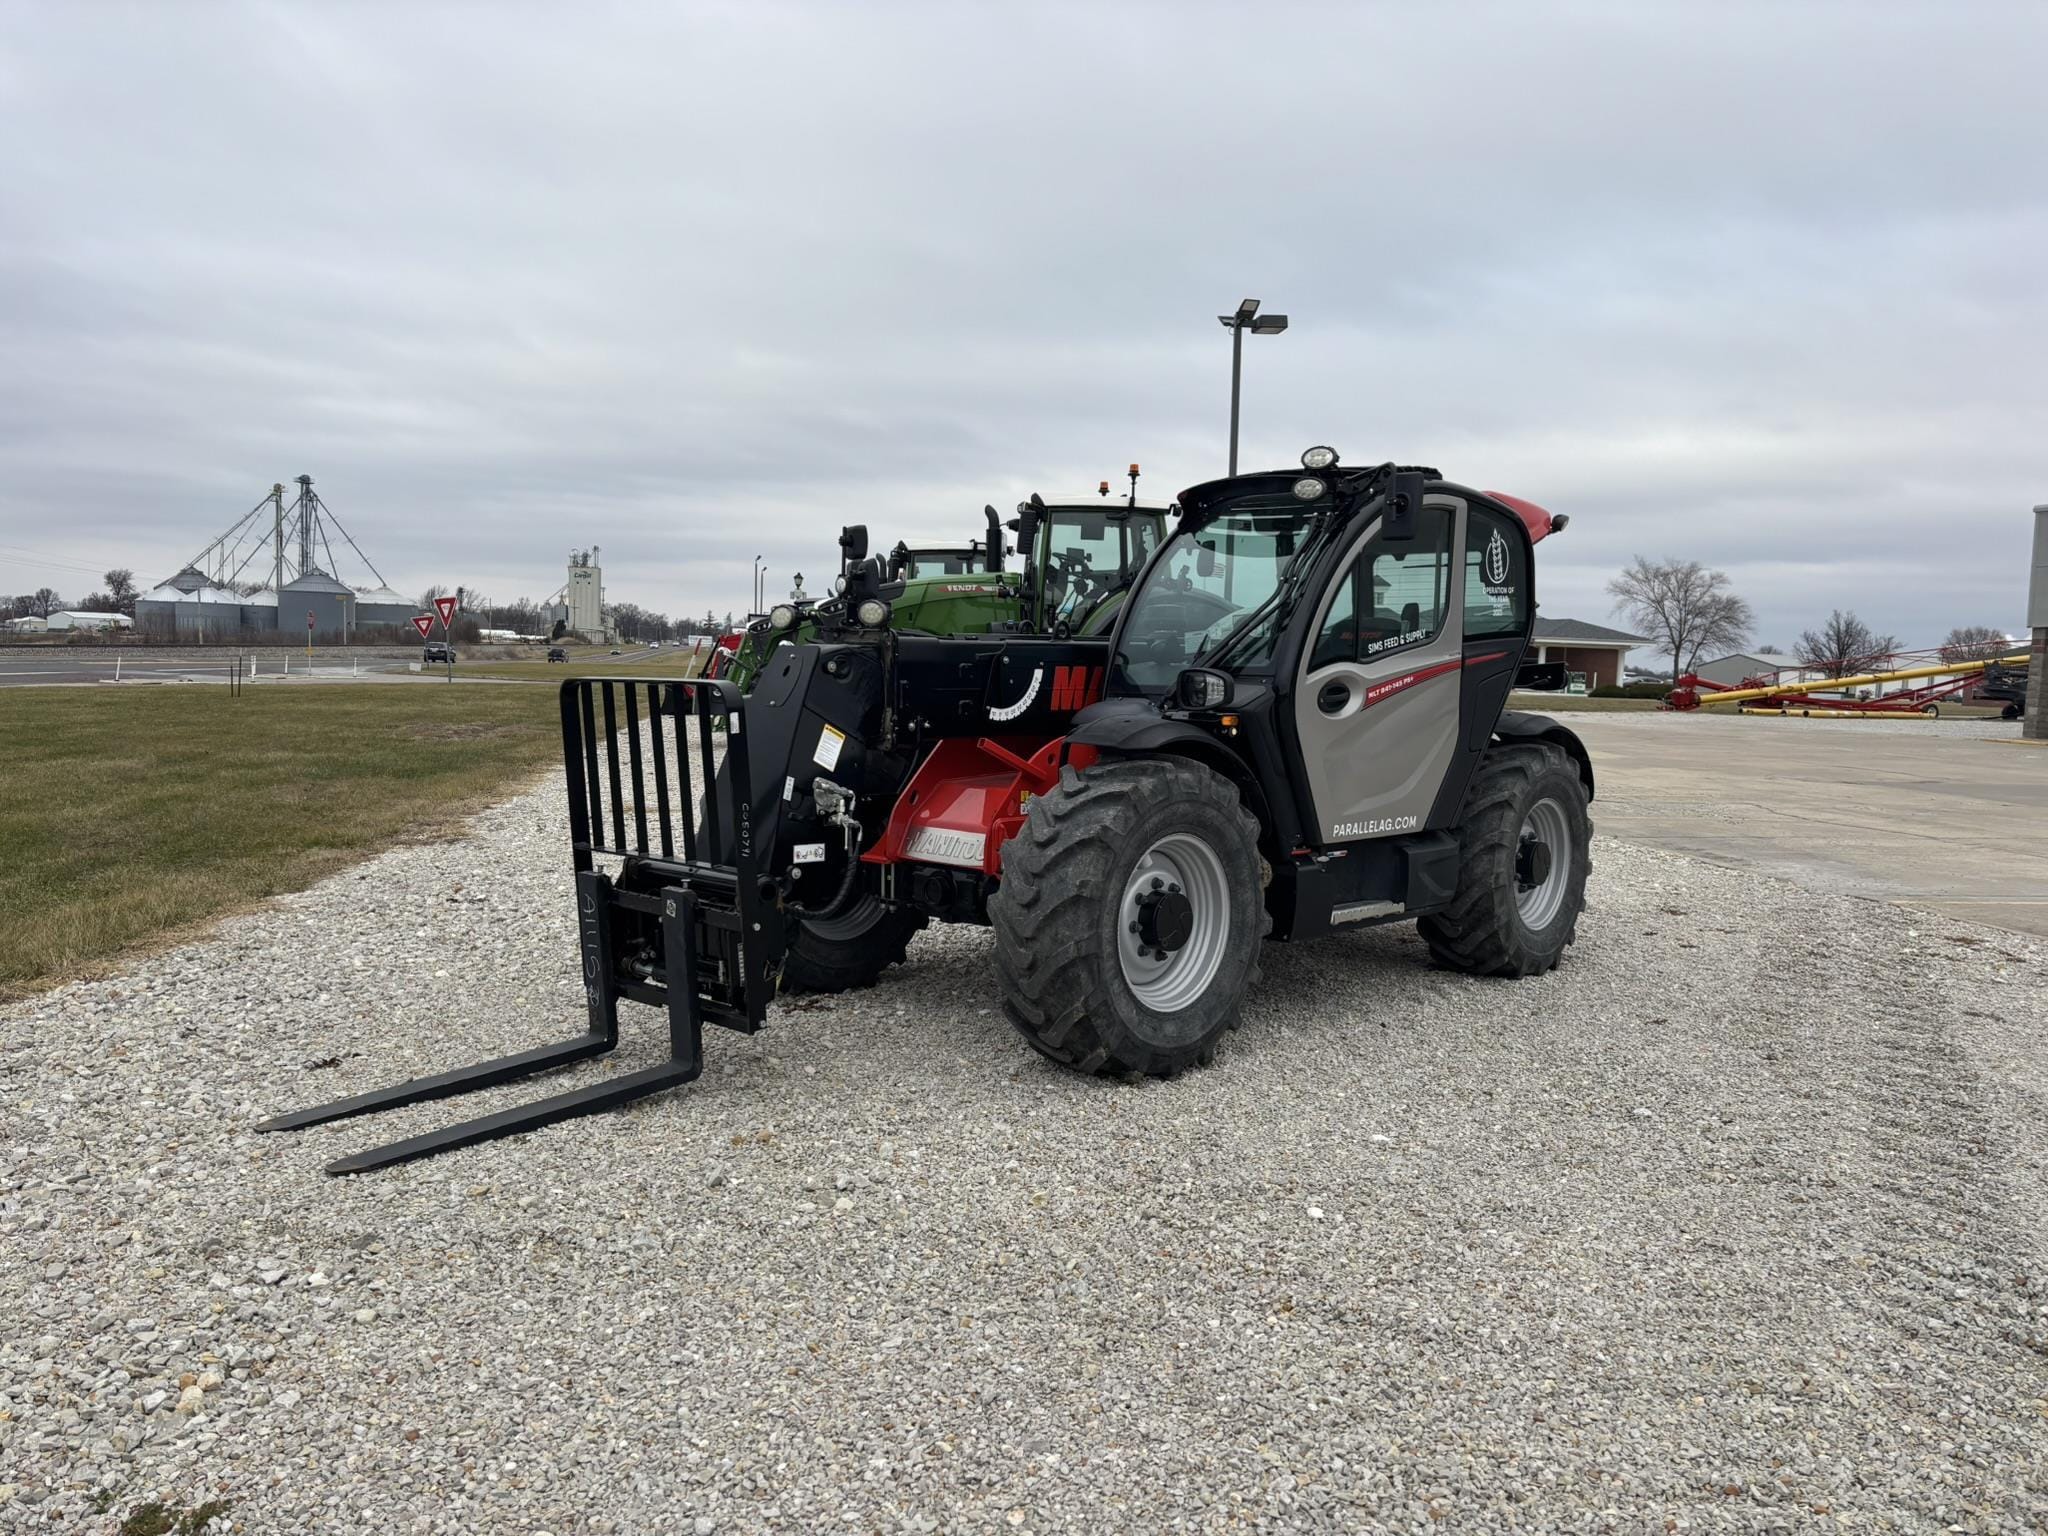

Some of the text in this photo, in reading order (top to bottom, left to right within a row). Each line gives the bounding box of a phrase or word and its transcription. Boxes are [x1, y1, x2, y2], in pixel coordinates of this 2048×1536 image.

[947, 584, 978, 592] FENDT
[1368, 640, 1384, 654] SIMS
[1384, 636, 1399, 650] FEED
[1400, 635, 1405, 645] &
[1405, 628, 1426, 643] SUPPLY
[1333, 815, 1417, 838] PARALLELAG.COM
